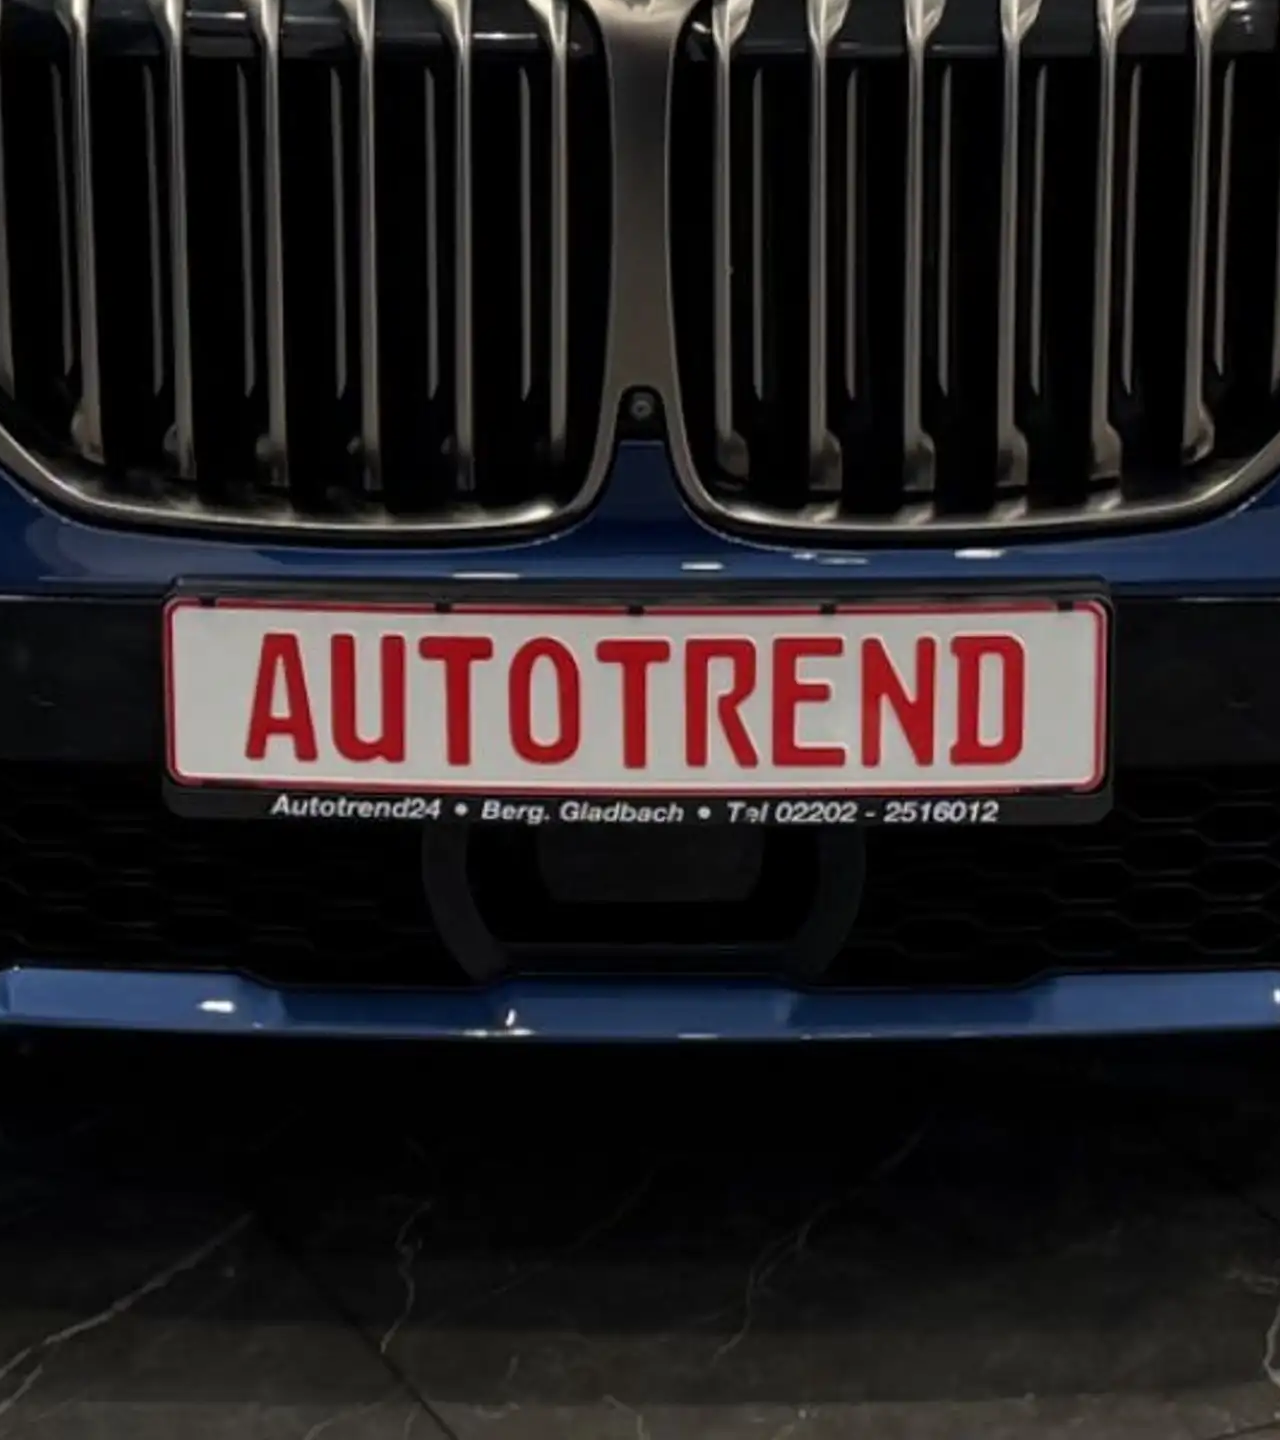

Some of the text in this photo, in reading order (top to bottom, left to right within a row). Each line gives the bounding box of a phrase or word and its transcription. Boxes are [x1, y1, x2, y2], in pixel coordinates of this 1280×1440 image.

[247, 633, 1026, 769] AUTOTREND
[271, 793, 442, 820] Autotrend24
[481, 799, 551, 825] Berg.
[559, 800, 685, 823] Gladbach
[774, 801, 859, 823] 02202
[883, 801, 1001, 823] 2516012
